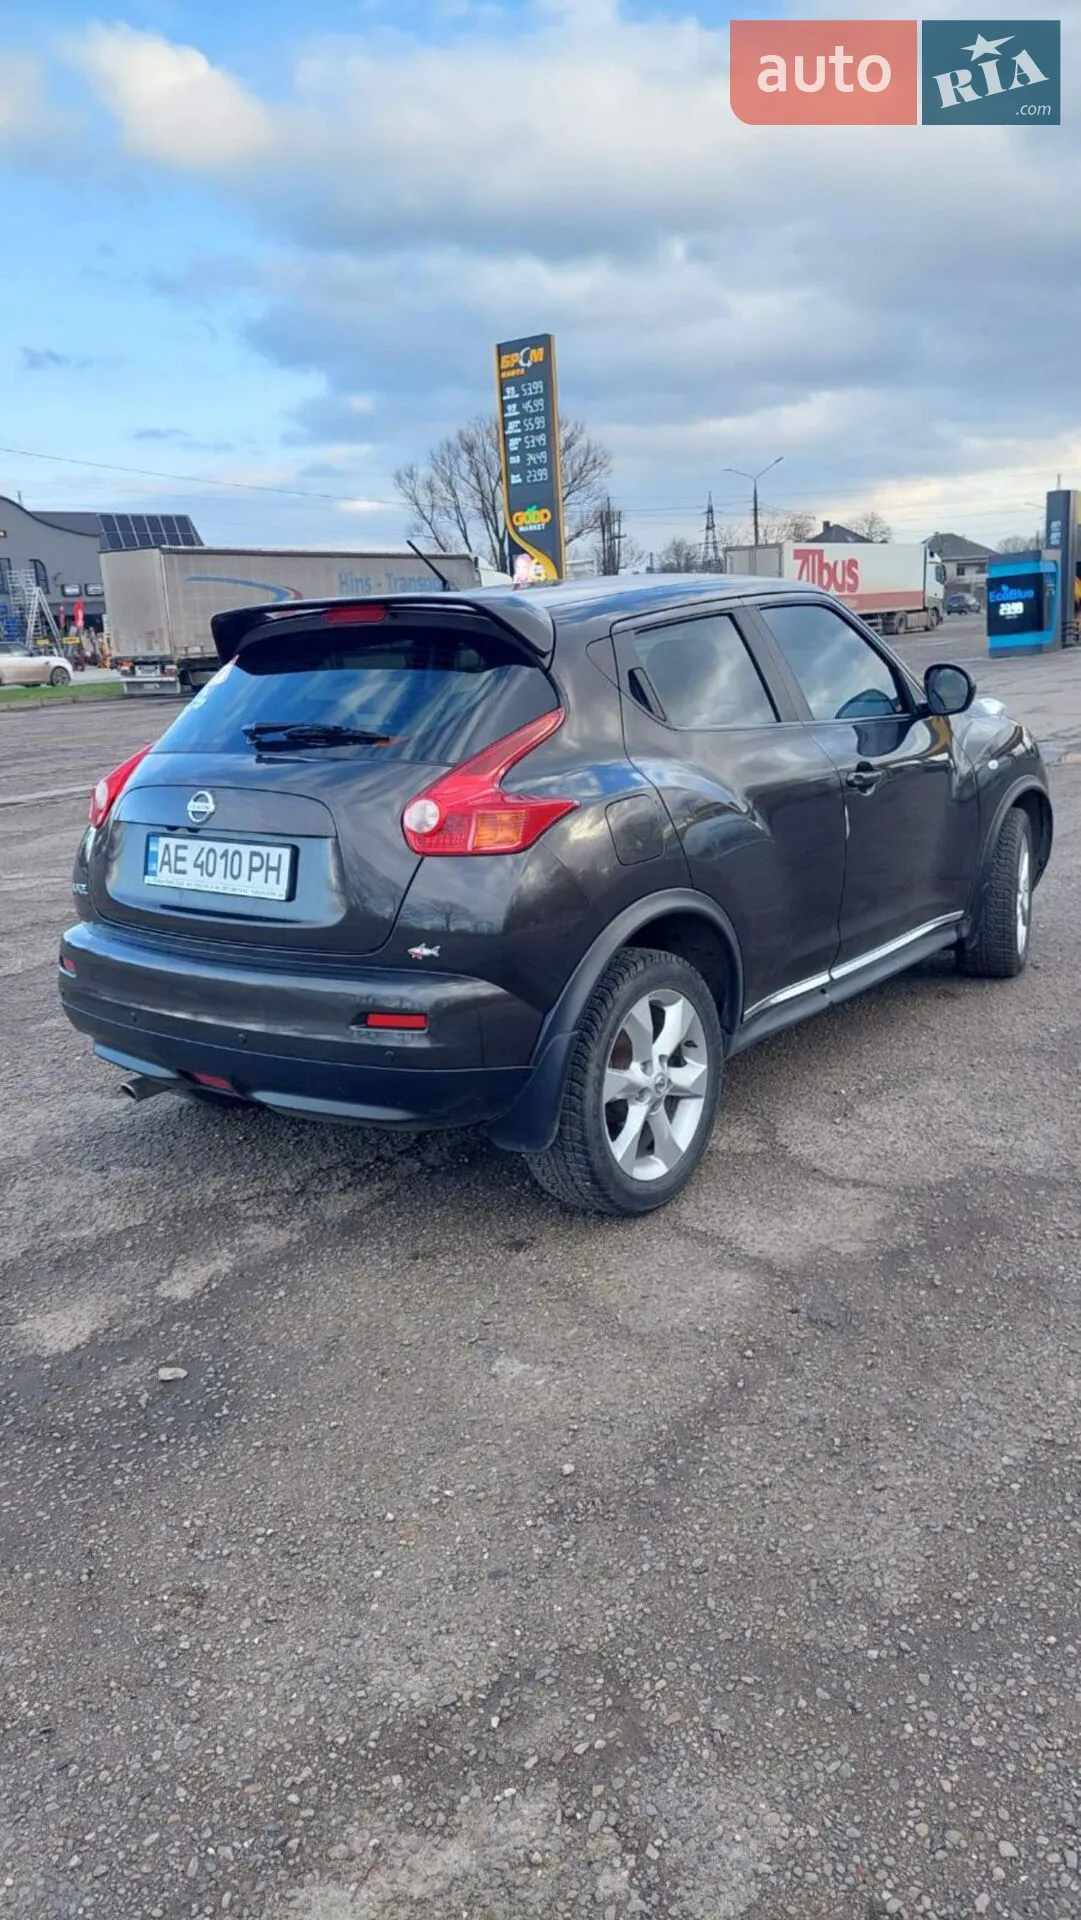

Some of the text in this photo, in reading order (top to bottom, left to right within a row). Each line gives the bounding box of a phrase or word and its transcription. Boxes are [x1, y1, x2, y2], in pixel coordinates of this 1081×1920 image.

[338, 572, 372, 593] Hins
[159, 843, 282, 885] AE 4010 PH
